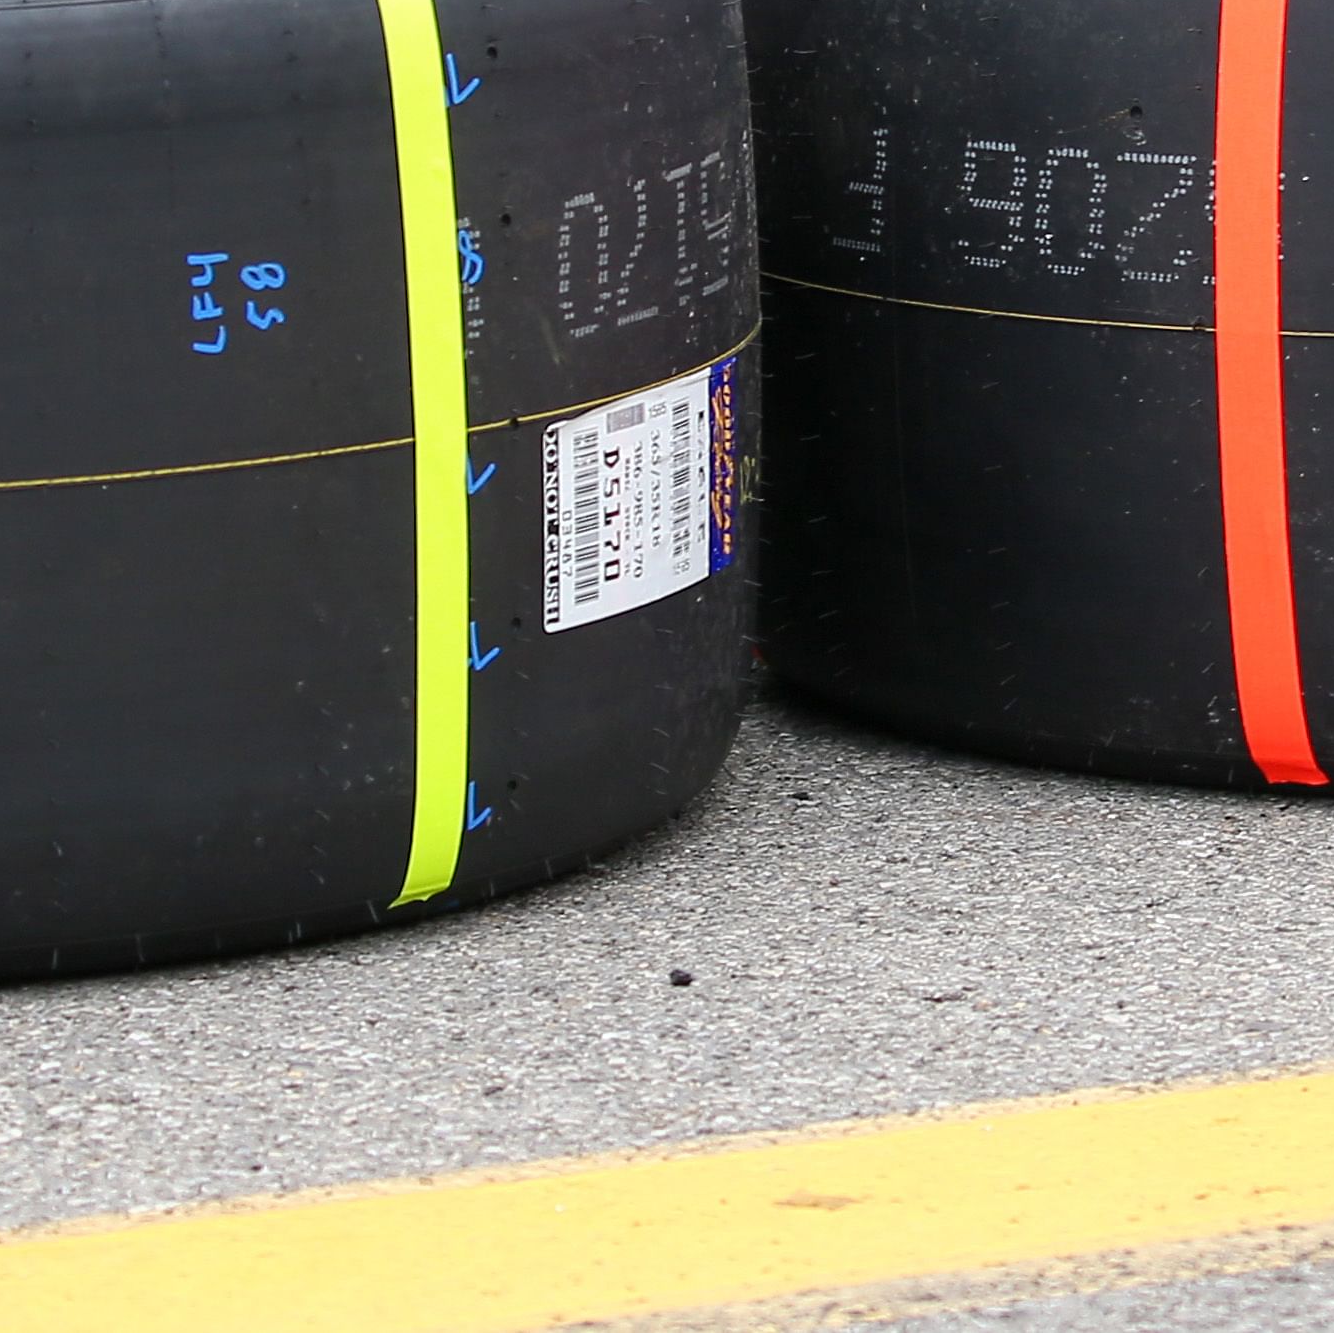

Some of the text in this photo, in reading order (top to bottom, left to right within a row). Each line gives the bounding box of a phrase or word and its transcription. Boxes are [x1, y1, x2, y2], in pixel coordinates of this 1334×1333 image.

[186, 251, 229, 355] LF4
[240, 261, 287, 331] 58
[544, 460, 561, 522] NOT
[603, 447, 621, 582] D5170
[544, 538, 561, 625] CRUSH
